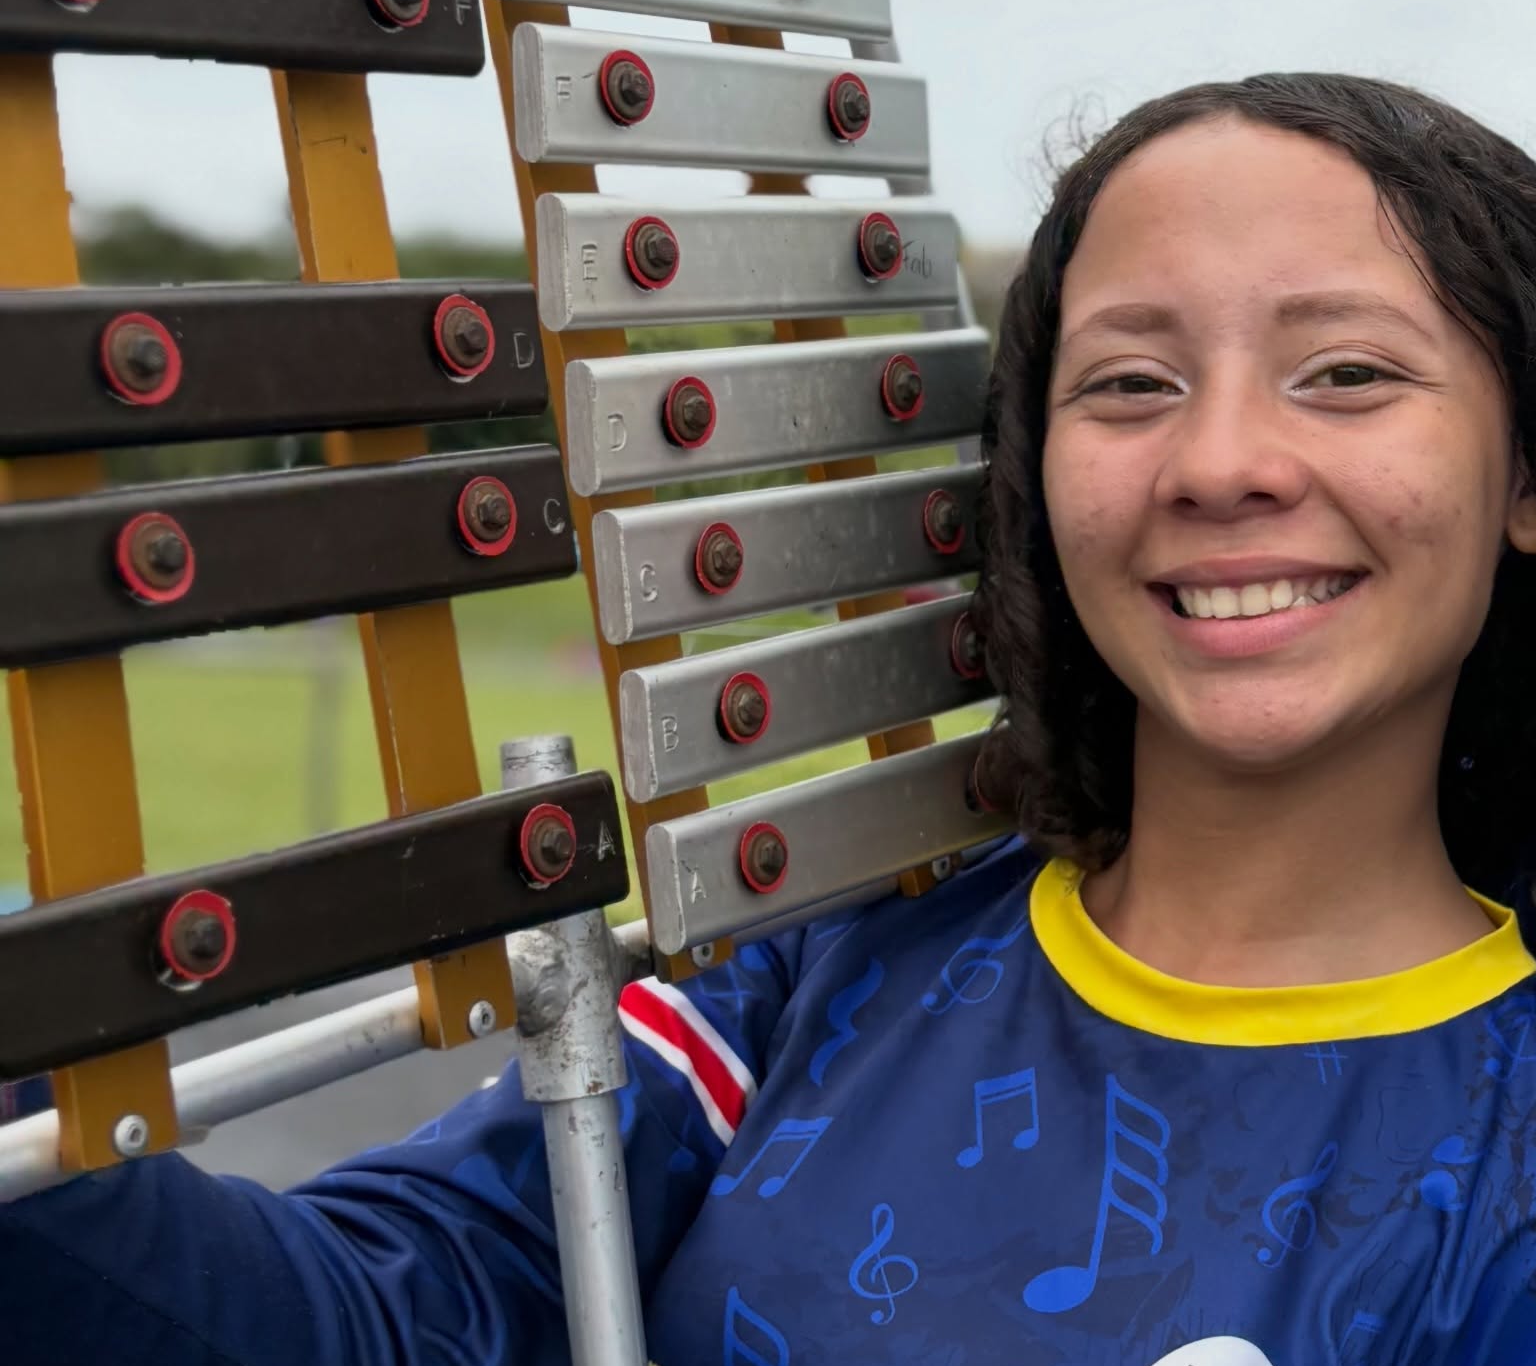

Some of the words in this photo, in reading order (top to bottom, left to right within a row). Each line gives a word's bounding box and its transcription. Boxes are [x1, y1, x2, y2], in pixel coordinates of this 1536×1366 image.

[581, 243, 599, 282] E
[513, 332, 534, 369] D
[607, 413, 627, 453] D
[543, 498, 565, 534] C
[640, 563, 658, 603] C
[660, 715, 680, 754] B
[598, 820, 616, 861] A
[690, 868, 708, 904] A
